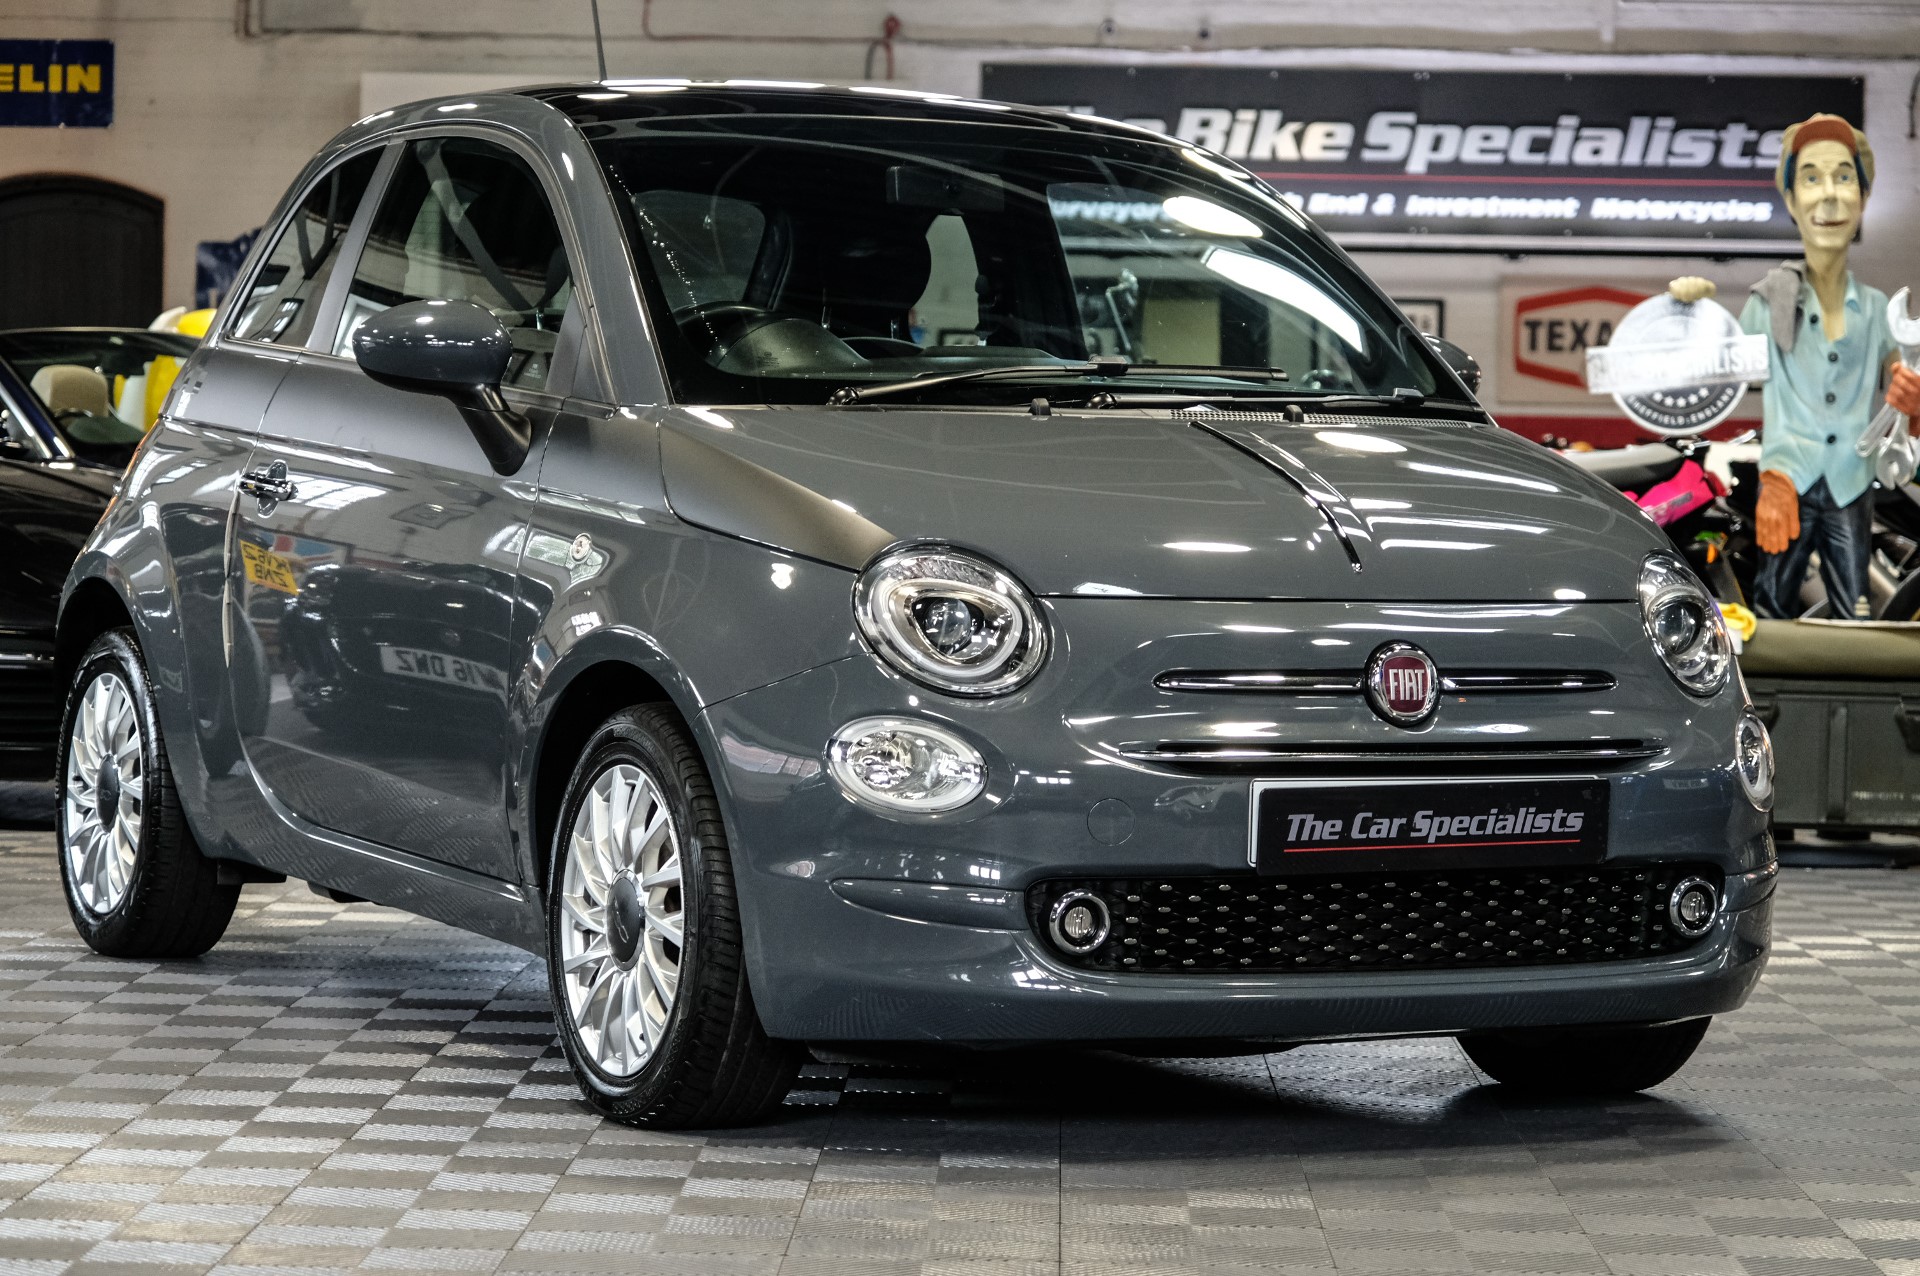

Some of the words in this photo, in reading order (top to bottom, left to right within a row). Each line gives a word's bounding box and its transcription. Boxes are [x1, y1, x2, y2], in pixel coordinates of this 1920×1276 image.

[1176, 107, 1355, 162] Bike
[1360, 112, 1784, 174] Specialists
[1371, 192, 1396, 216] &
[1404, 194, 1581, 219] Investment
[1590, 197, 1773, 224] Motorcycles
[1389, 668, 1425, 701] FIAT
[1286, 813, 1343, 842] The
[1350, 811, 1407, 839] Car
[1409, 806, 1585, 843] Specialists
